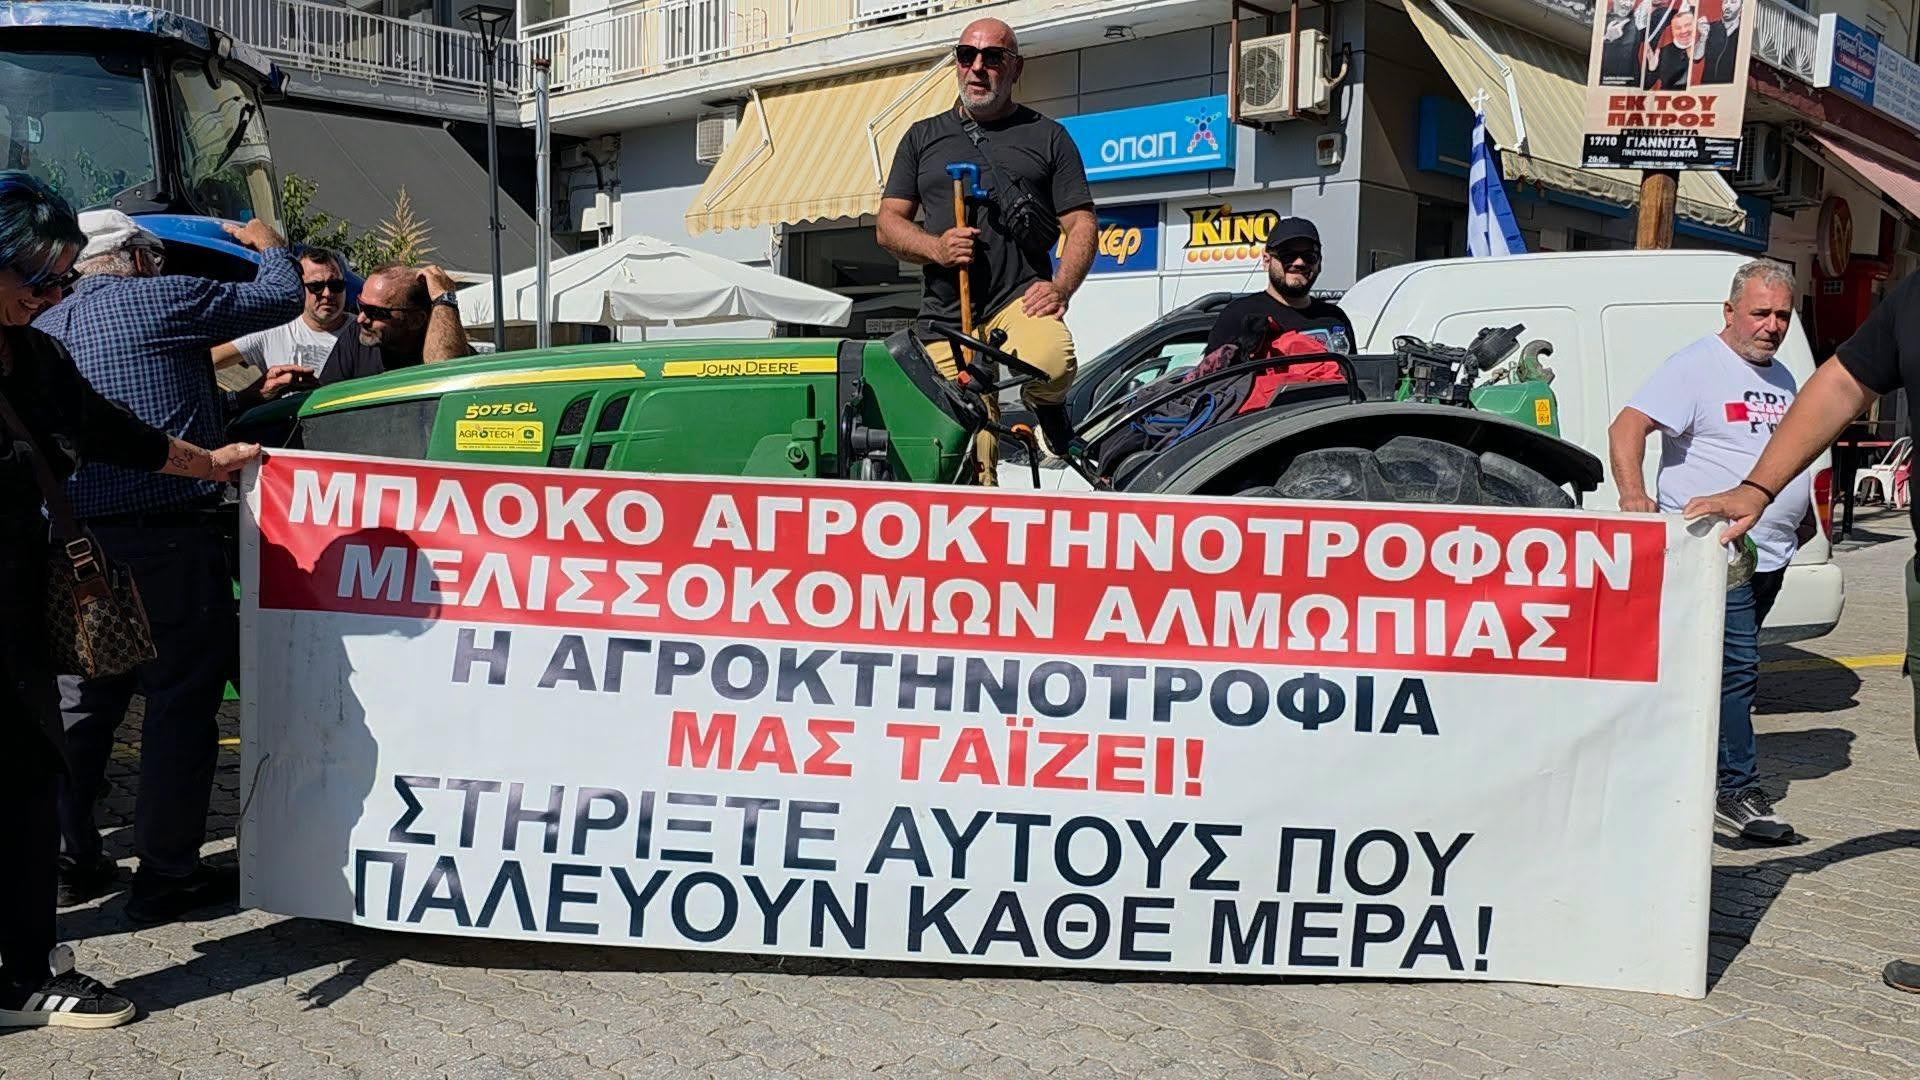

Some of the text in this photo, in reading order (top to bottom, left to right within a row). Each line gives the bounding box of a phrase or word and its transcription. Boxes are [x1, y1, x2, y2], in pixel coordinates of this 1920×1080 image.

[1609, 95, 1718, 111] ΕΚ ΤΟΥ
[1607, 113, 1716, 127] ΠΑΤΡΟΣ
[1589, 136, 1617, 147] 17/10
[1626, 137, 1697, 149] ΓΙΑΝΝΙΤΣΑ
[1621, 148, 1699, 158] ΠΝΕΥΜΑΤΙΚΟ ΚΕΝΤΡΟ
[697, 361, 799, 375] JOHN DEERE
[465, 401, 538, 419] 5075 GL
[288, 470, 1633, 591] ΜΠΛΟΚΟ ΑΓΡΟΚΤΗΝΟΤΡΟΦΩΝ
[336, 544, 1571, 663] ΜΕΛΙΣΣΟΚΟΜΩΝ ΑΛΜΩΠΙΑΣ
[451, 628, 1440, 736] Η ΑΓΡΟΚΤΗΝΟΤΡΟΦΙΑ
[667, 711, 1204, 797] ΜΑΣ ΤΑΪΖΕΙ!
[388, 775, 1475, 897] ΣΤΗΡΙΞΤΕ ΑΥΤΟΥΣ ΠΟΥ
[355, 849, 1493, 972] ΠΑΛΕΥΟΥΝ ΚΑΘΕ ΜΕΡΑ!
